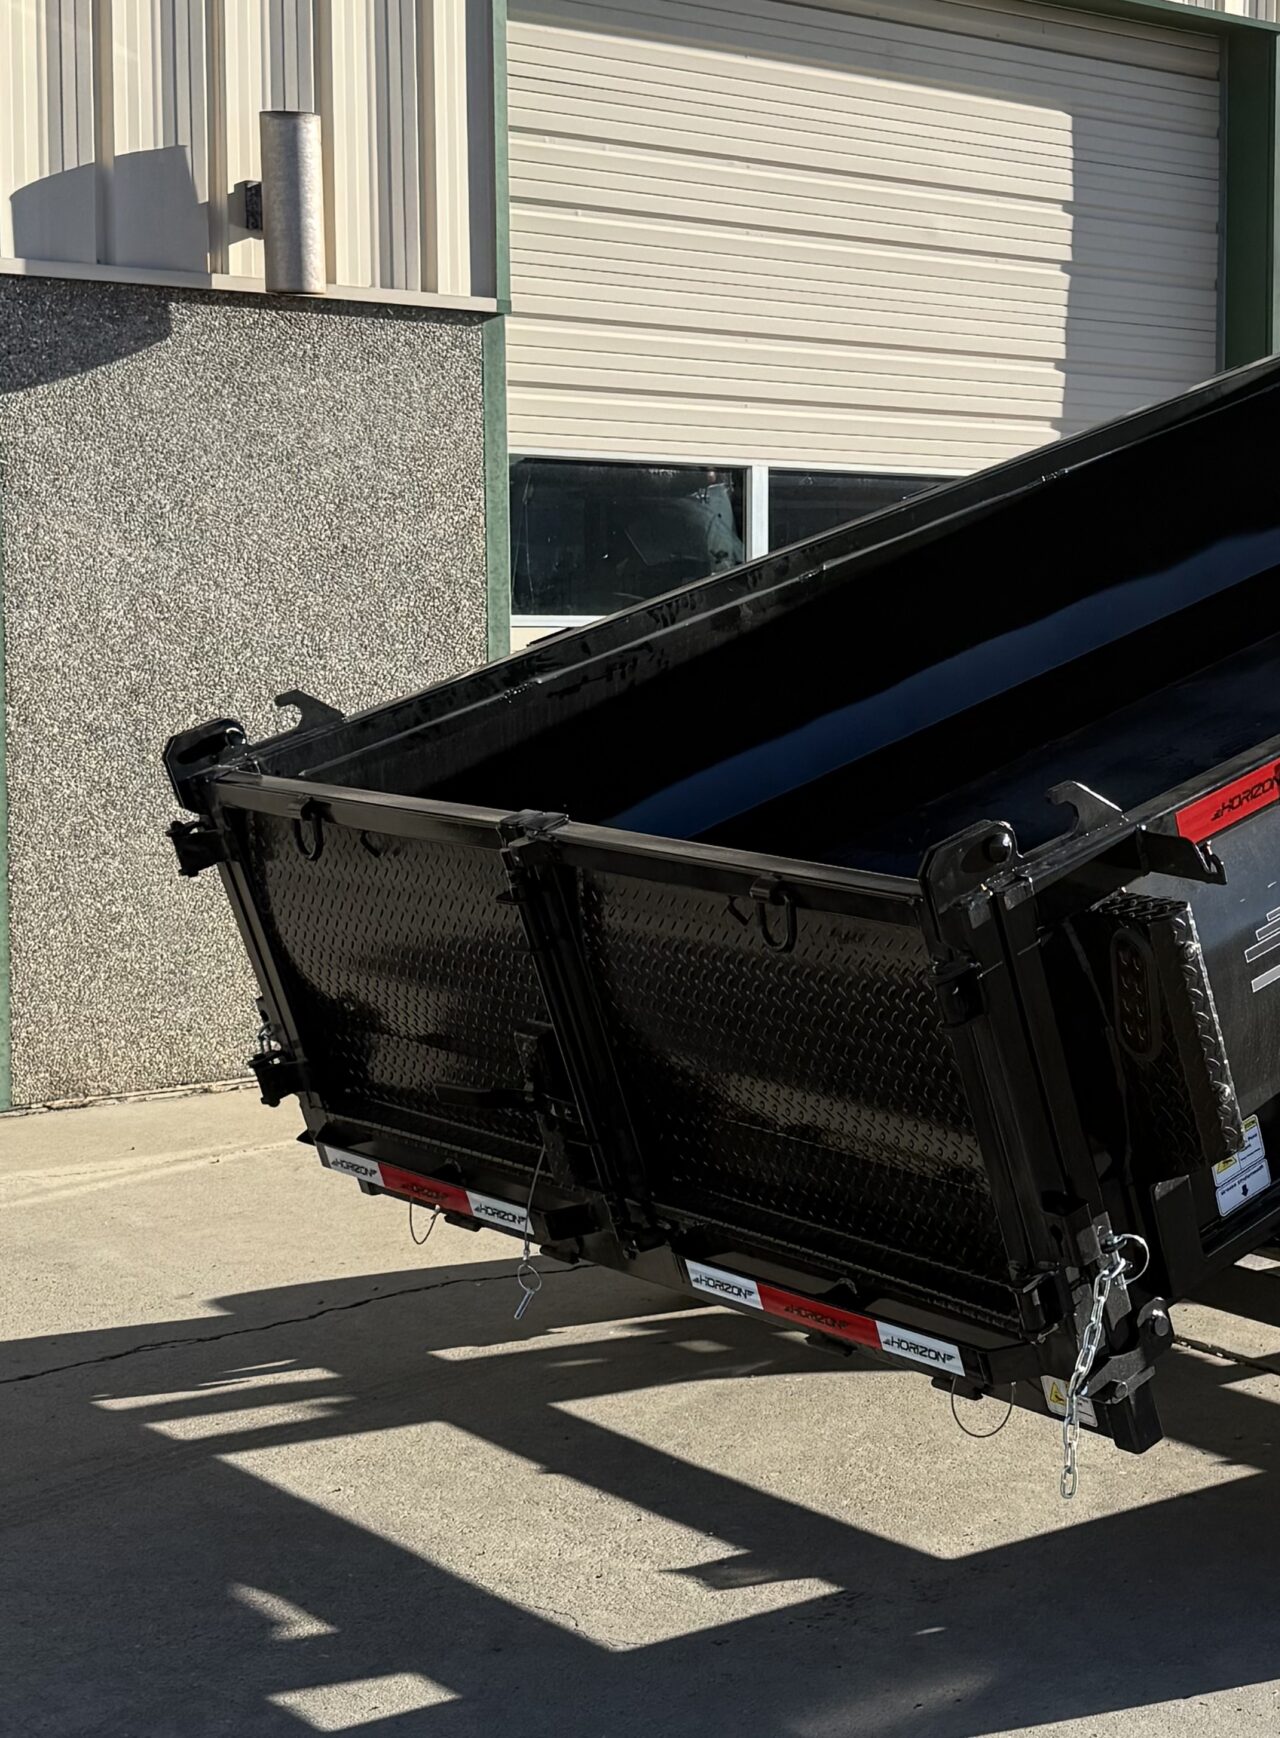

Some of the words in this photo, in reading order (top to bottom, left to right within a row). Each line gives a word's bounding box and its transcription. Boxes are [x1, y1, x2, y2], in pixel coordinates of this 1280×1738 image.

[336, 1158, 371, 1177] HORIZON
[480, 1205, 520, 1225] HORIZON
[700, 1276, 748, 1299] HORIZON
[790, 1305, 841, 1329] HORIZON
[890, 1336, 947, 1363] HORIZON
